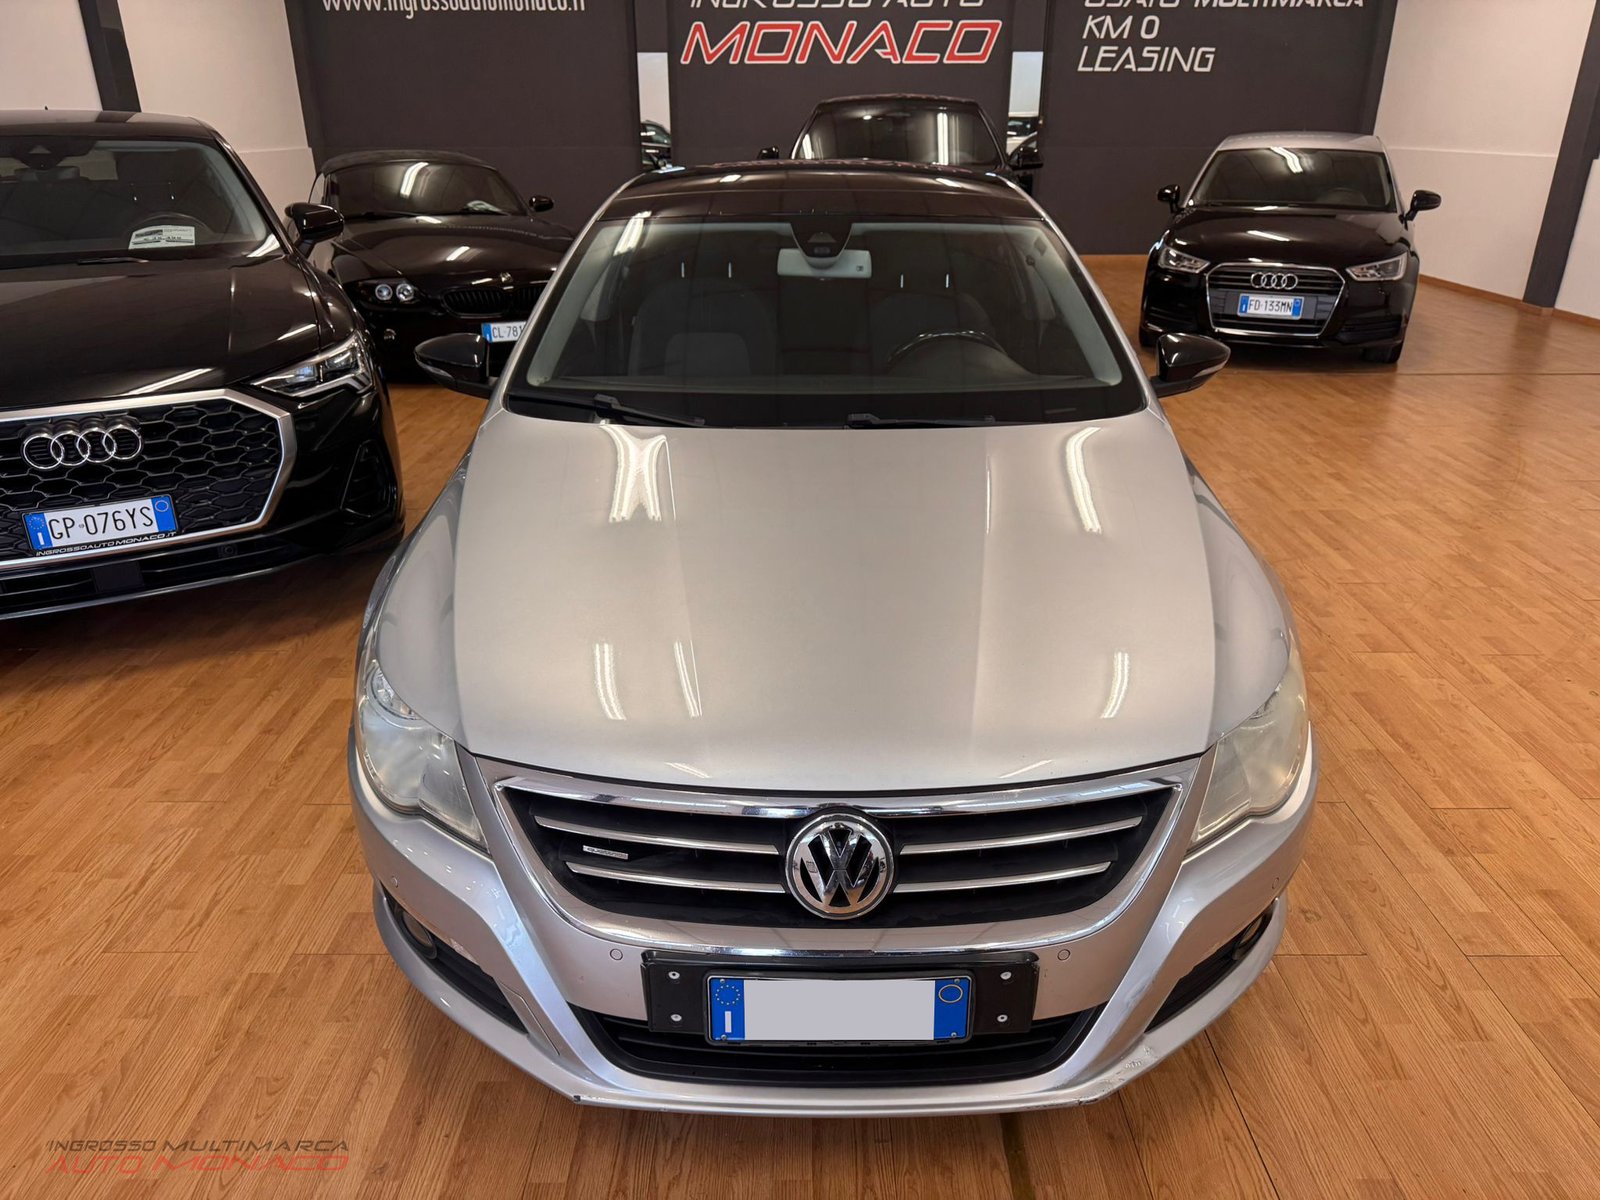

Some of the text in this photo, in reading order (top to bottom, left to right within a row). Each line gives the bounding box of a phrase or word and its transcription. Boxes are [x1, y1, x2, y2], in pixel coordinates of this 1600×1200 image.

[680, 20, 1002, 64] MONACO
[1082, 15, 1133, 39] KM
[1077, 46, 1216, 72] LEASING
[49, 517, 75, 540] GP
[83, 506, 154, 536] 076YS
